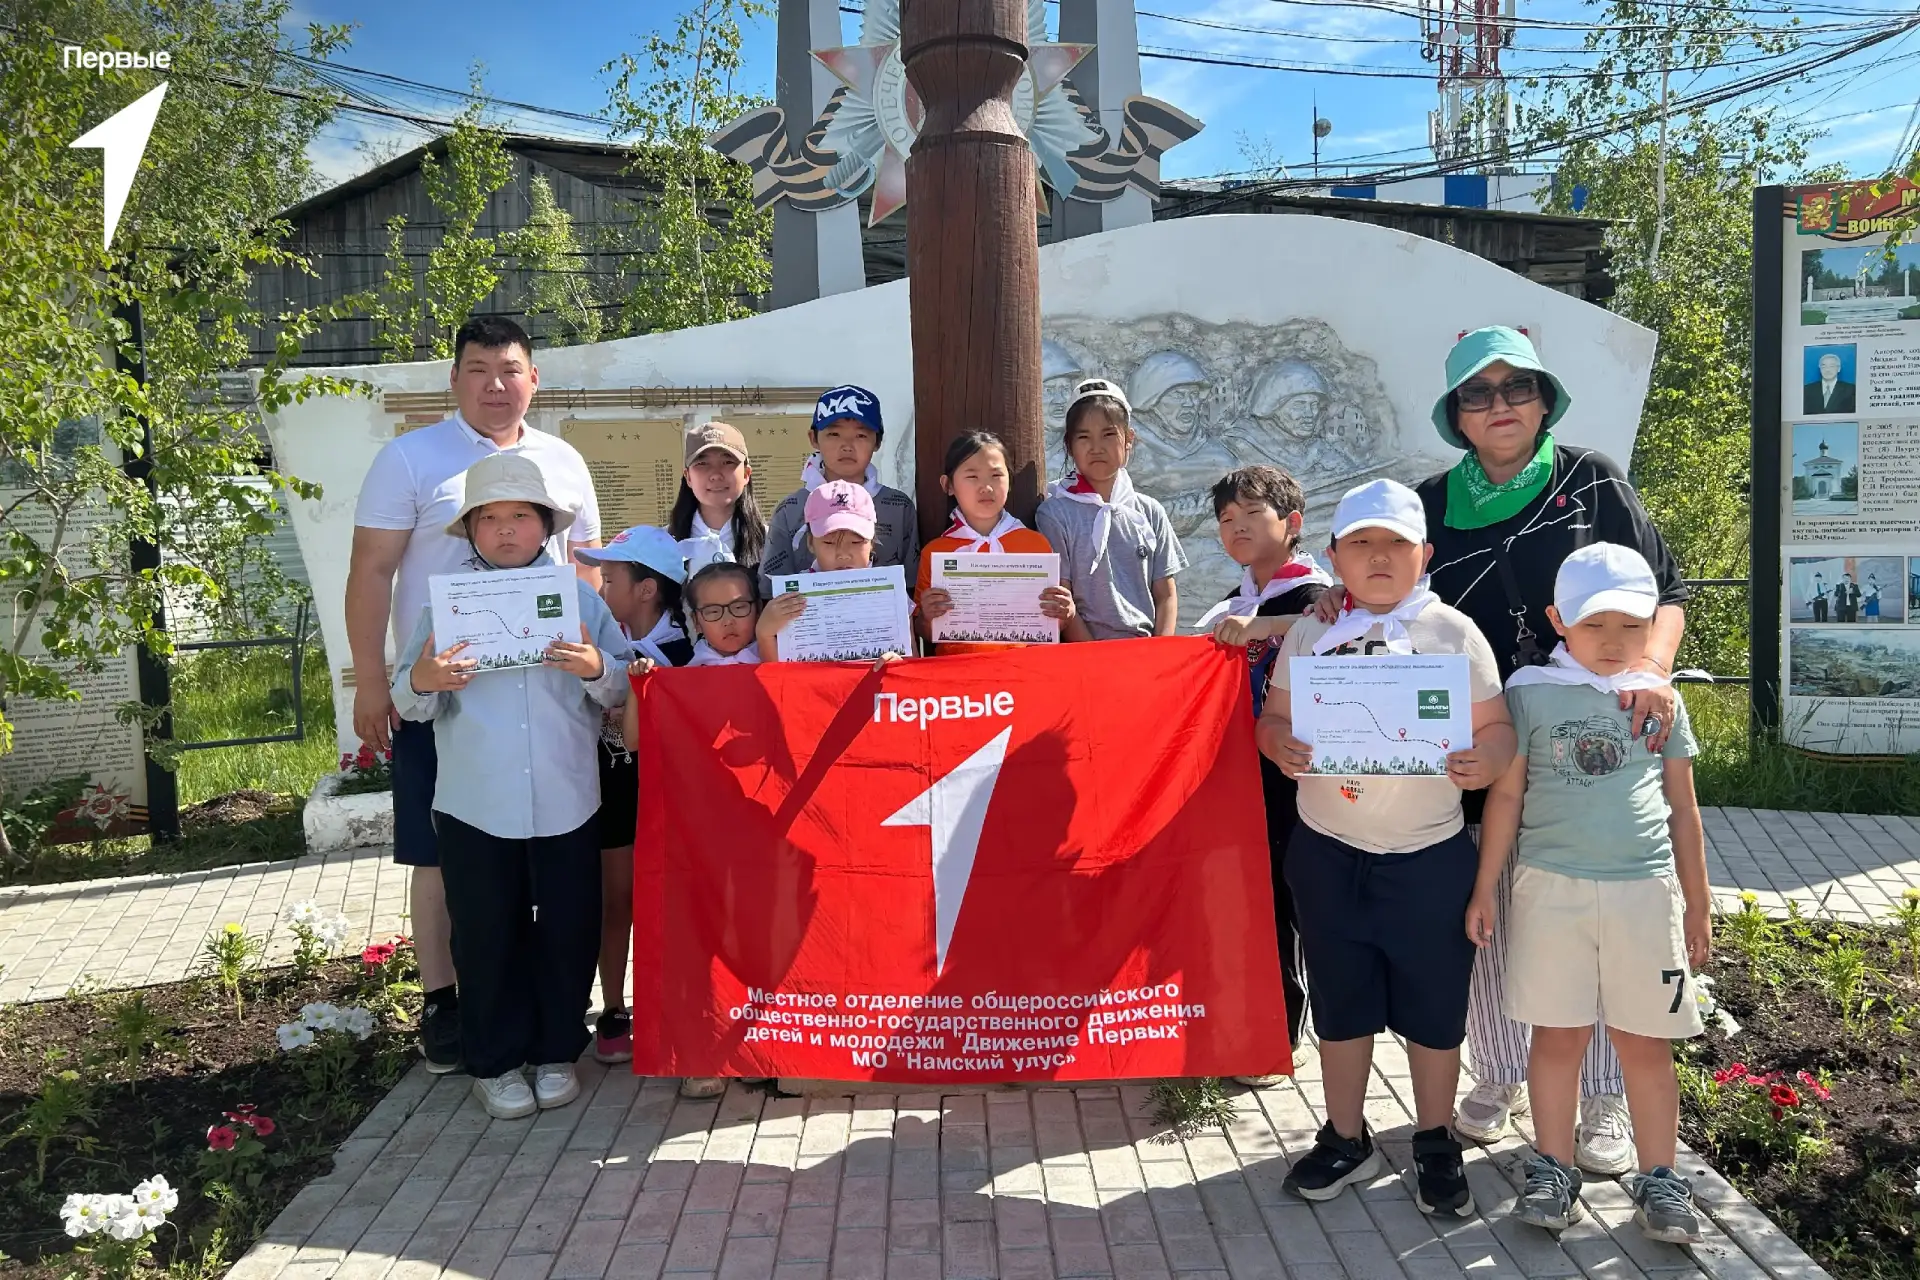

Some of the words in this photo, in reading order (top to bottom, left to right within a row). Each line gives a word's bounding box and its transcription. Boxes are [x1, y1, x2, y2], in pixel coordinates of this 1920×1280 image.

[874, 691, 1014, 731] Первые
[1566, 777, 1595, 788] ATTACK!
[748, 987, 837, 1009] Местное
[845, 993, 964, 1011] отделение
[971, 983, 1180, 1014] общероссийского
[1661, 969, 1685, 1014] 7
[729, 1004, 1079, 1037] общественно-государственного
[1087, 1004, 1206, 1029] движения
[744, 1025, 803, 1043] детей
[810, 1033, 822, 1047] и
[830, 1034, 945, 1052] молодежи
[953, 1031, 1079, 1054] "Движение
[1087, 1020, 1188, 1046] Первых"
[852, 1050, 888, 1068] МО
[896, 1049, 1004, 1071] "Намский
[1012, 1053, 1077, 1072] улус»
